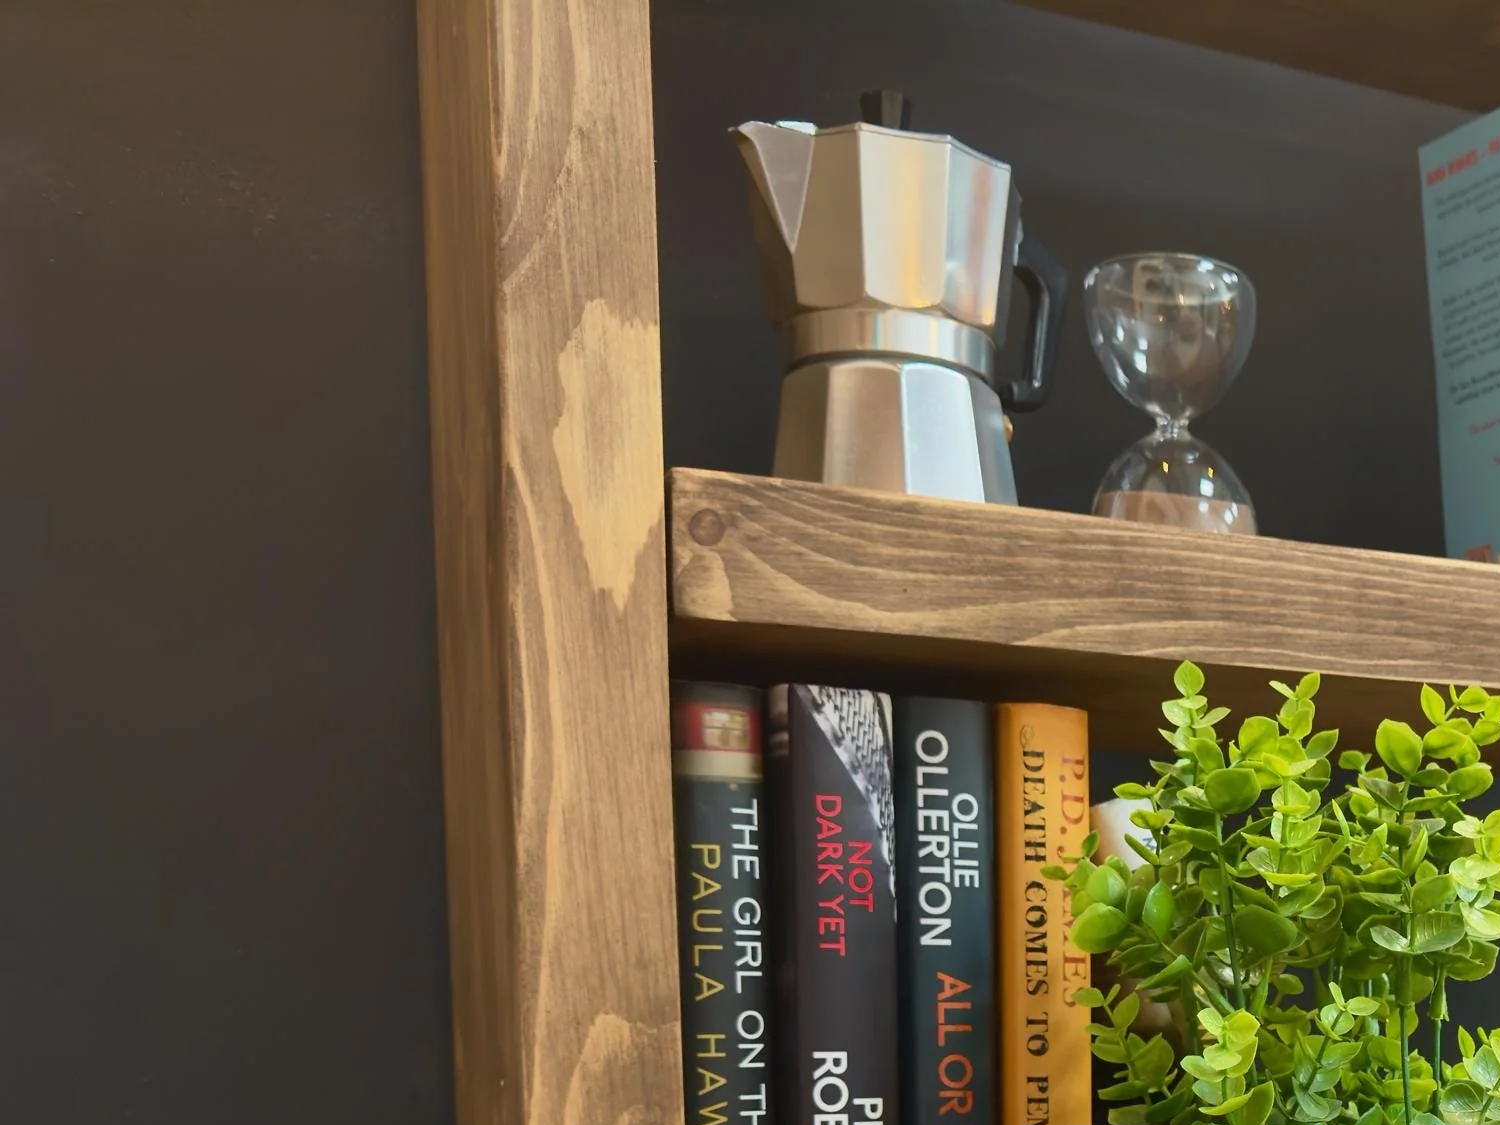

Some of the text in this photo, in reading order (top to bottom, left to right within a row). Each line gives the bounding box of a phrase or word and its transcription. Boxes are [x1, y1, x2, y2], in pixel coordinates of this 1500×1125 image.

[729, 798, 760, 879] THE
[915, 730, 952, 946] OLLERTON
[951, 793, 980, 889] OLLIE
[1022, 750, 1047, 862] DEATH
[690, 843, 725, 1002] PAULA
[815, 793, 846, 957] DARK YET
[848, 840, 874, 913] NOT
[733, 897, 763, 994] GIRL
[1024, 880, 1049, 996] COMES
[736, 1010, 765, 1068] ON
[936, 971, 973, 1047] ALL
[1026, 1012, 1050, 1057] TO
[937, 1054, 974, 1116] OR
